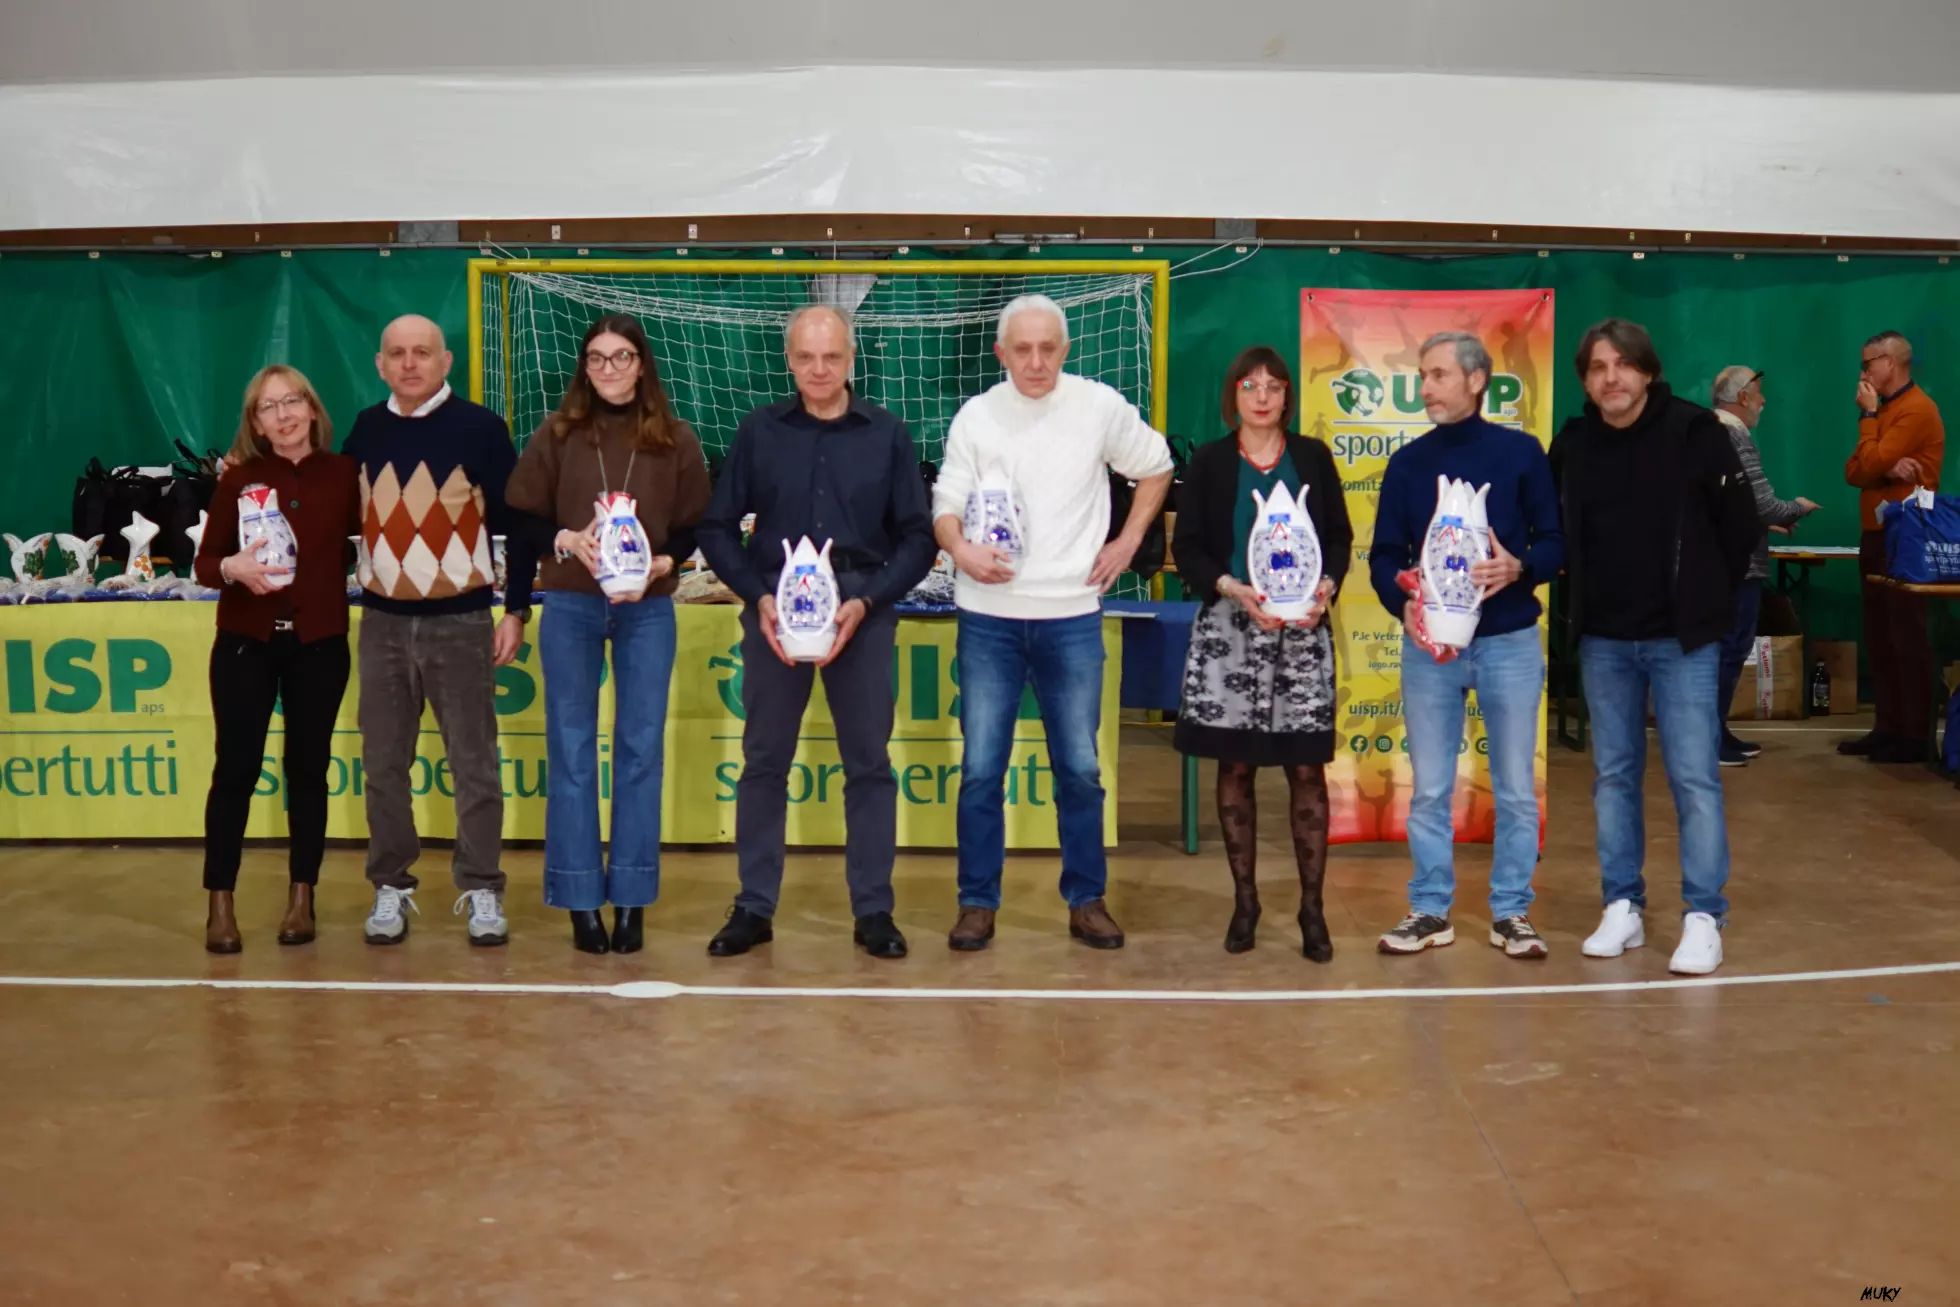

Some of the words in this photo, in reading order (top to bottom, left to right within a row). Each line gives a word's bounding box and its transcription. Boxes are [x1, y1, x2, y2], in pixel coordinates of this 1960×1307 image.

[1373, 631, 1404, 641] Veter
[141, 702, 164, 716] aps
[1349, 700, 1404, 718] uisp.it/
[0, 739, 178, 796] ertutti
